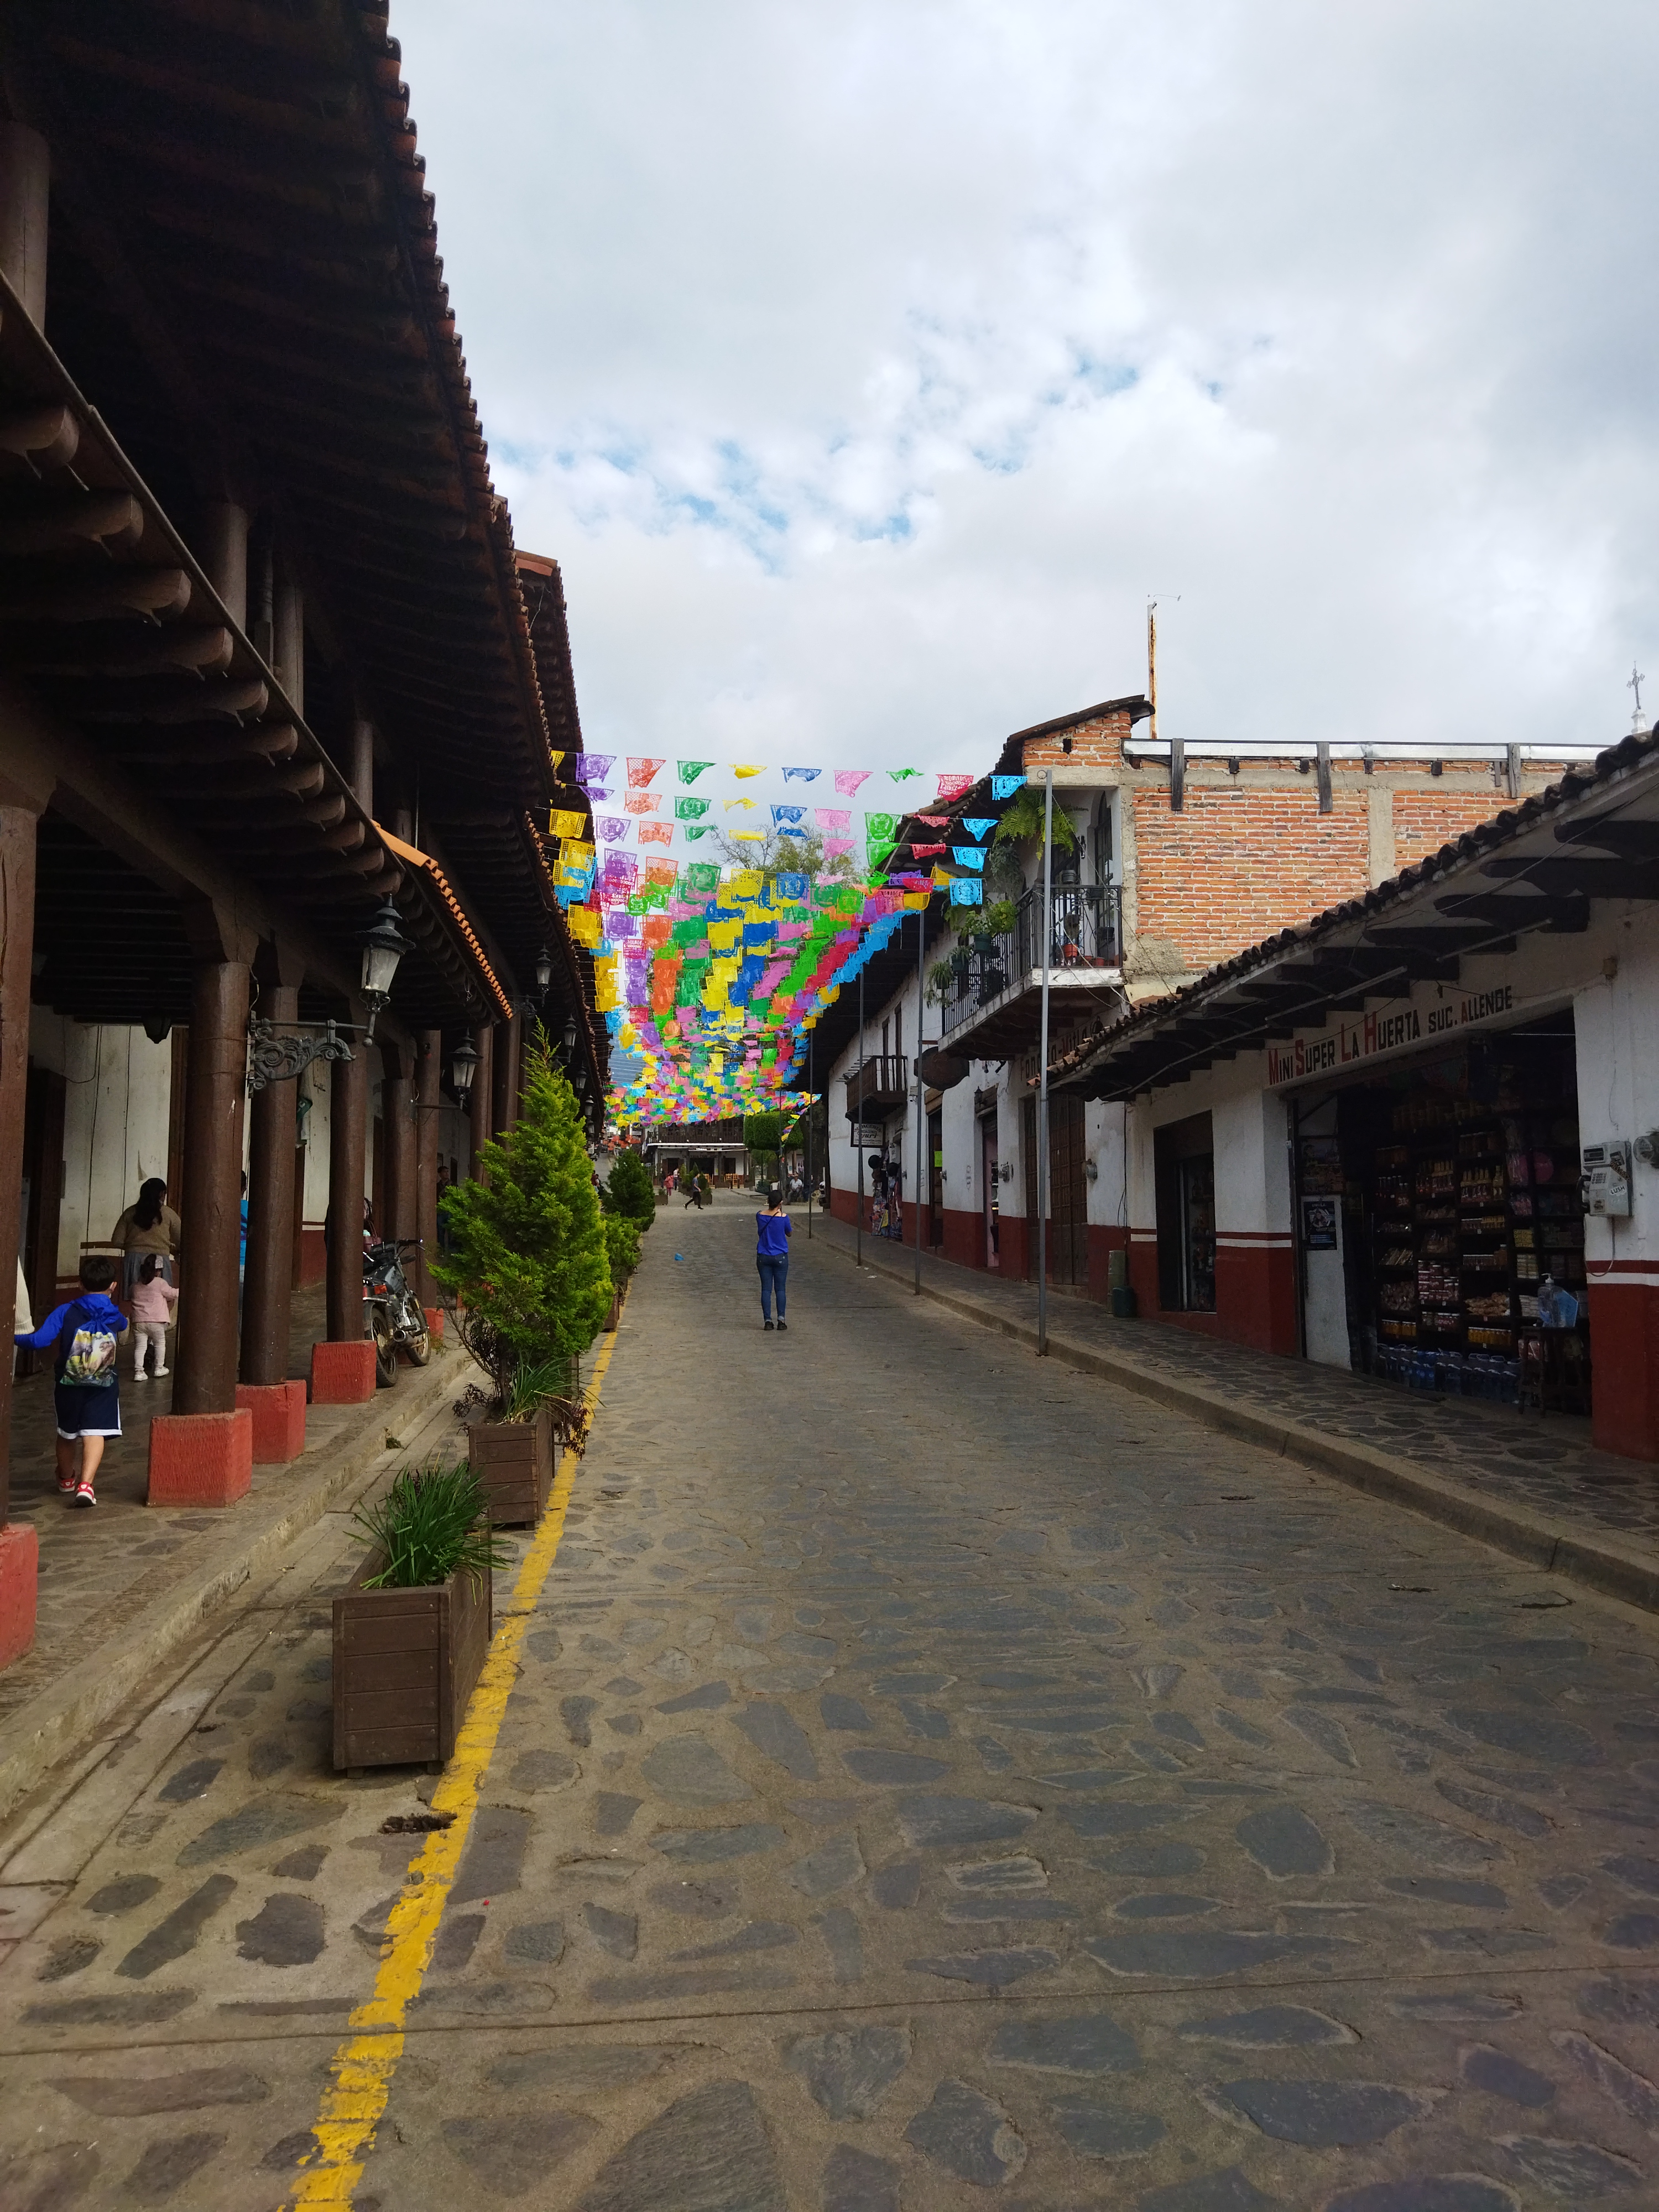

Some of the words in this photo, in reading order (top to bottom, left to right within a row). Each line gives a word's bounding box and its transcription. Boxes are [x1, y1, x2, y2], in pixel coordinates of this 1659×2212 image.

[1269, 1048, 1293, 1086] MINI
[1295, 1039, 1335, 1077] SUPER
[1340, 1023, 1360, 1062] LA
[1364, 1011, 1421, 1056] HUERTA
[1428, 1005, 1458, 1034] SUC.
[1461, 985, 1512, 1024] ALLENDE
[1610, 1186, 1625, 1194] LUSH
